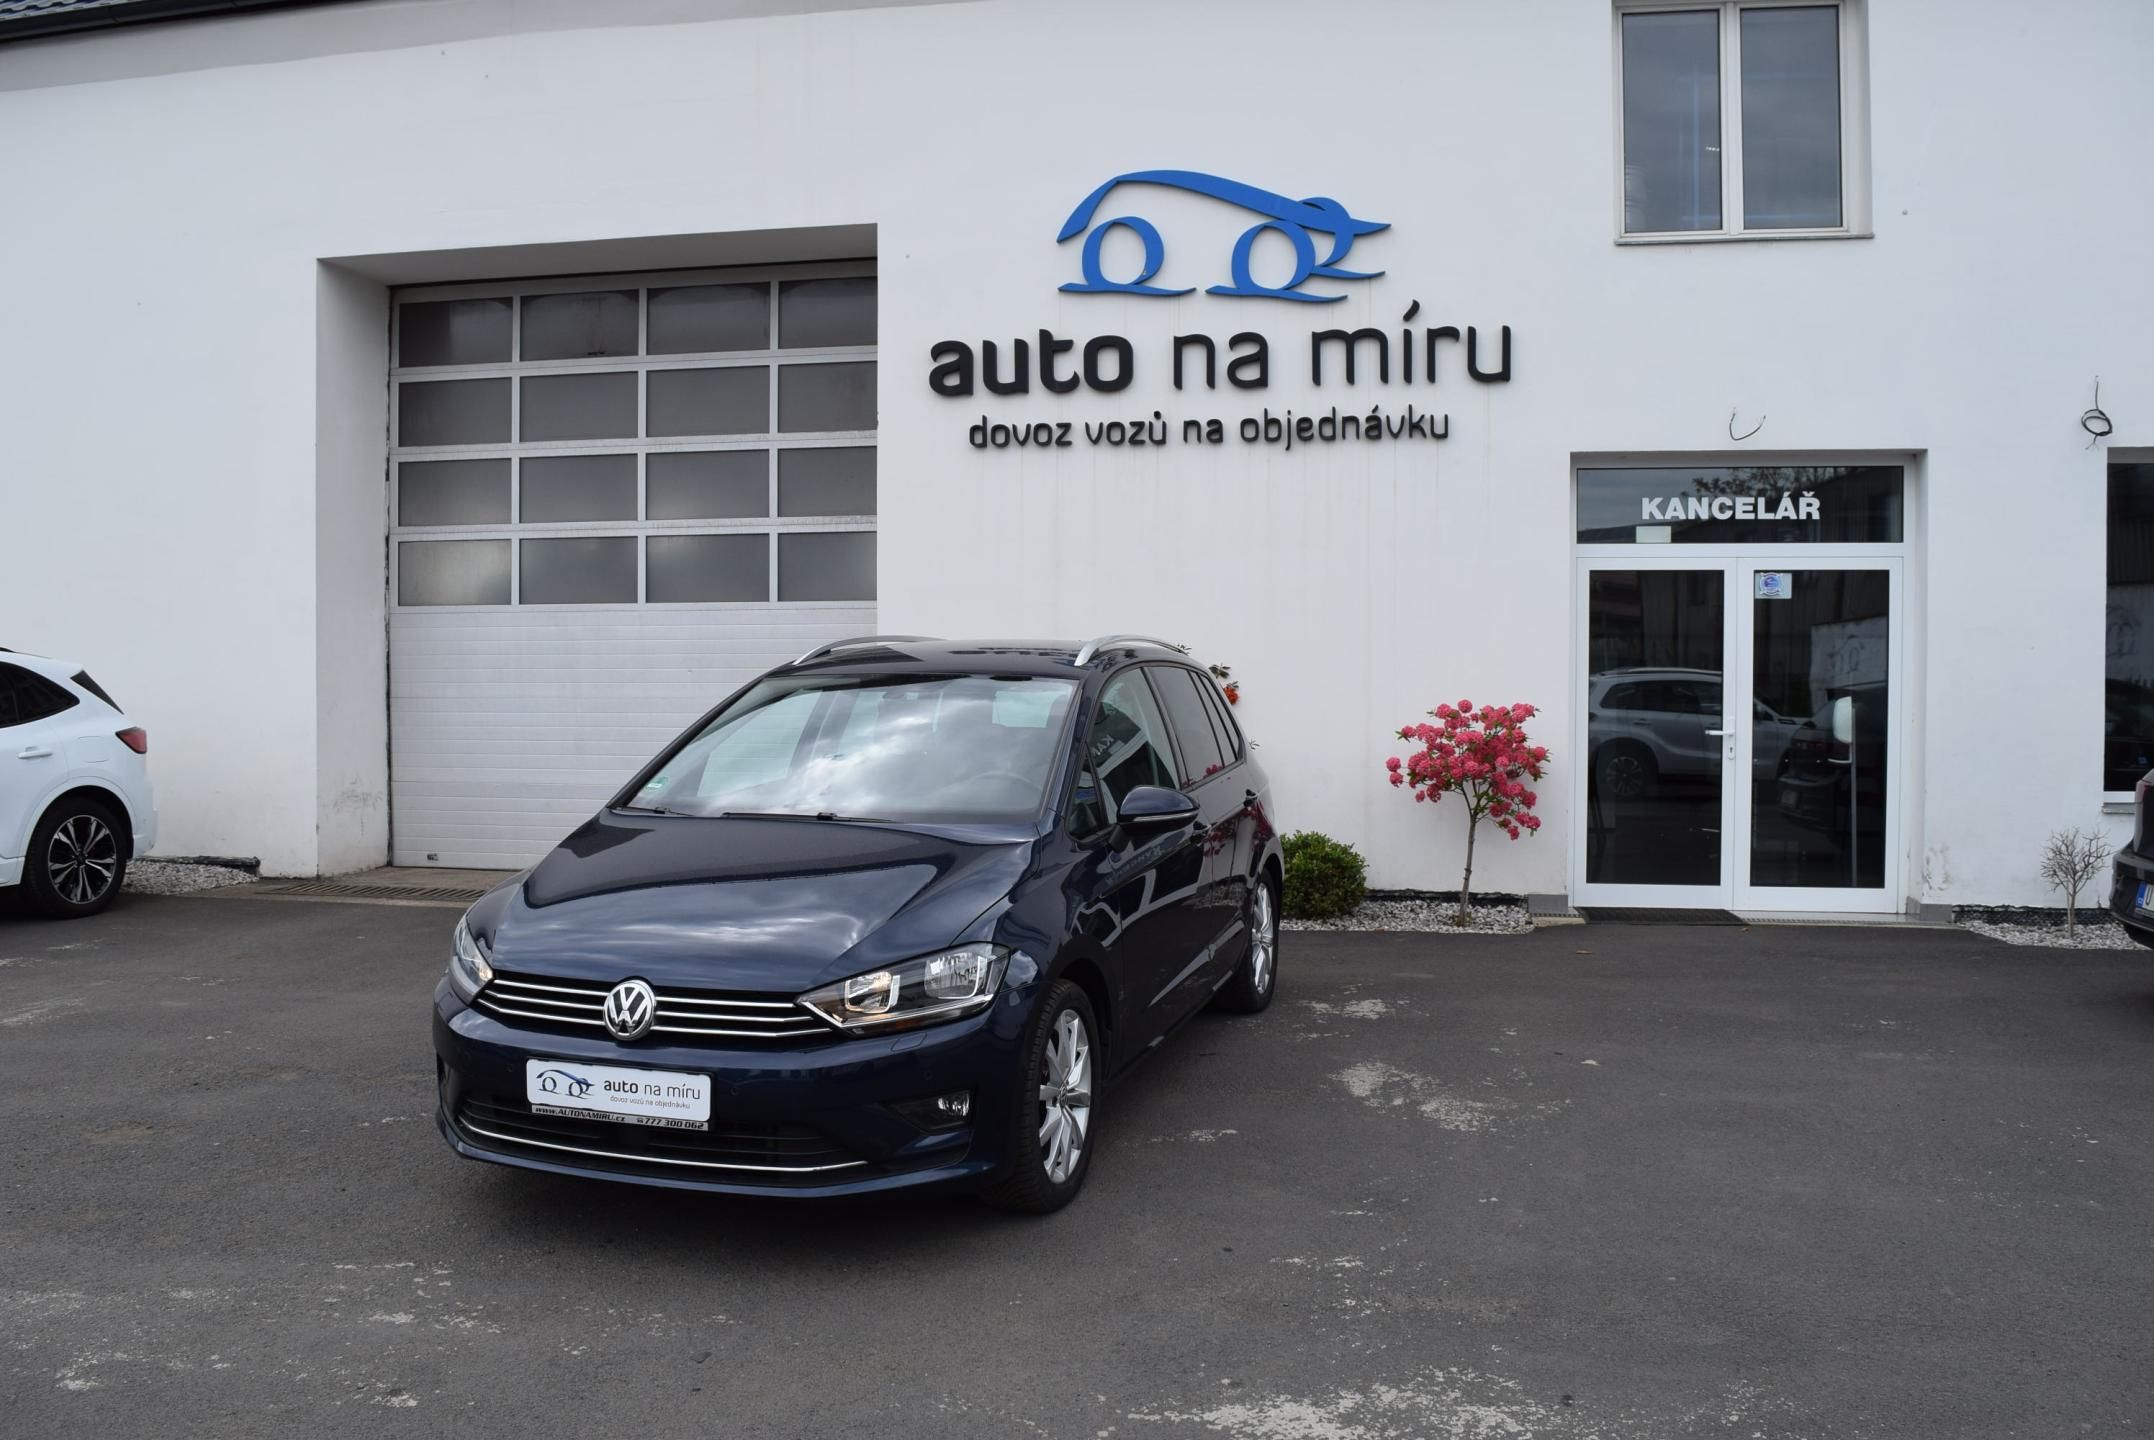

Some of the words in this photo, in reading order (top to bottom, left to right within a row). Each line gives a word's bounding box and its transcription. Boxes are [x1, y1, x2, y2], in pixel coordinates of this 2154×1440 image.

[928, 328, 1135, 397] auto
[1172, 331, 1270, 390] na
[1311, 300, 1512, 386] míru
[968, 415, 1074, 449] dovoz
[1084, 411, 1167, 446] vozů
[1182, 416, 1225, 445] na
[1239, 404, 1450, 451] objednávku
[1641, 491, 1821, 521] KANCELÁŘ
[603, 1080, 639, 1094] auto
[644, 1084, 662, 1096] na
[667, 1083, 701, 1100] míru
[664, 1119, 683, 1128] 300
